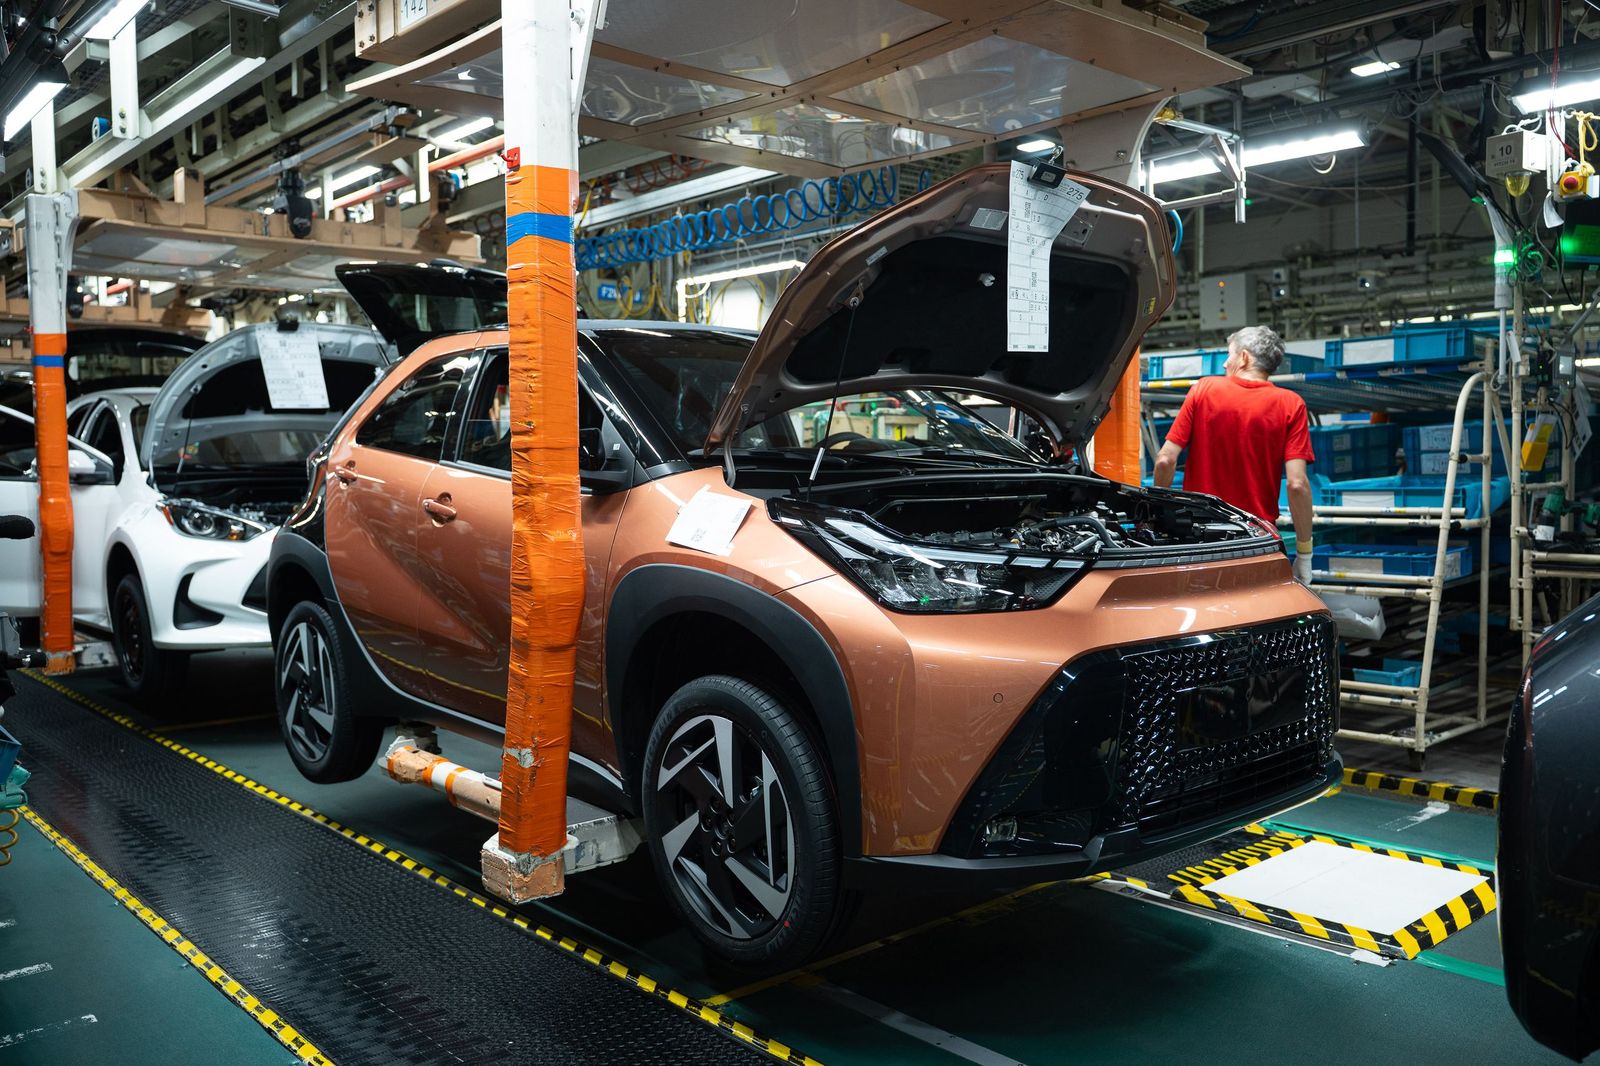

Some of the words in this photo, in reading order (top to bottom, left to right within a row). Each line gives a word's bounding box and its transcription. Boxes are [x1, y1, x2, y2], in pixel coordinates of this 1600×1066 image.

[1499, 144, 1513, 156] 10
[1015, 167, 1025, 180] 275
[1066, 187, 1085, 201] 275
